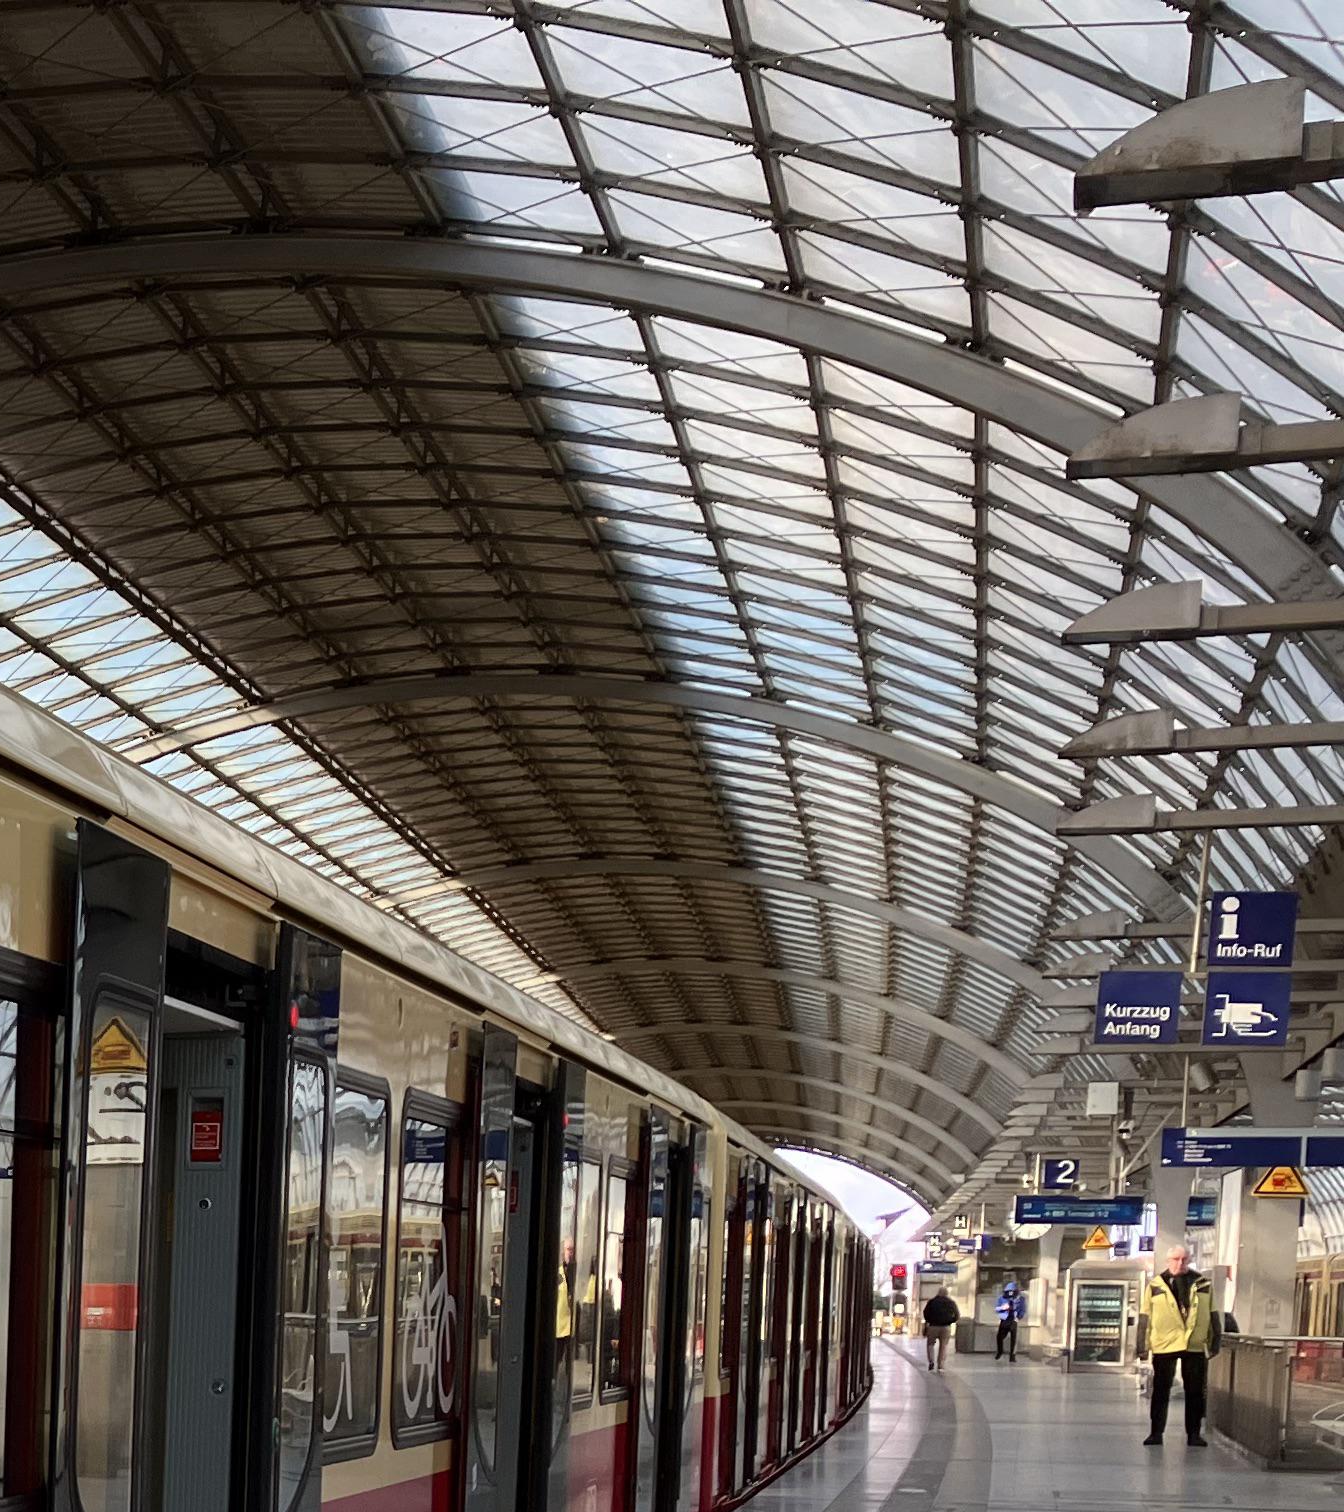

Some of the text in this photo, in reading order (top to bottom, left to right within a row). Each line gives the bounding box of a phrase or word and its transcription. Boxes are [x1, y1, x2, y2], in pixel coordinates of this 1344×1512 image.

[1216, 943, 1283, 958] Info-Ruf
[1104, 1003, 1171, 1021] Kurzzug
[1103, 1022, 1161, 1039] Anfang
[1055, 1159, 1075, 1184] 2
